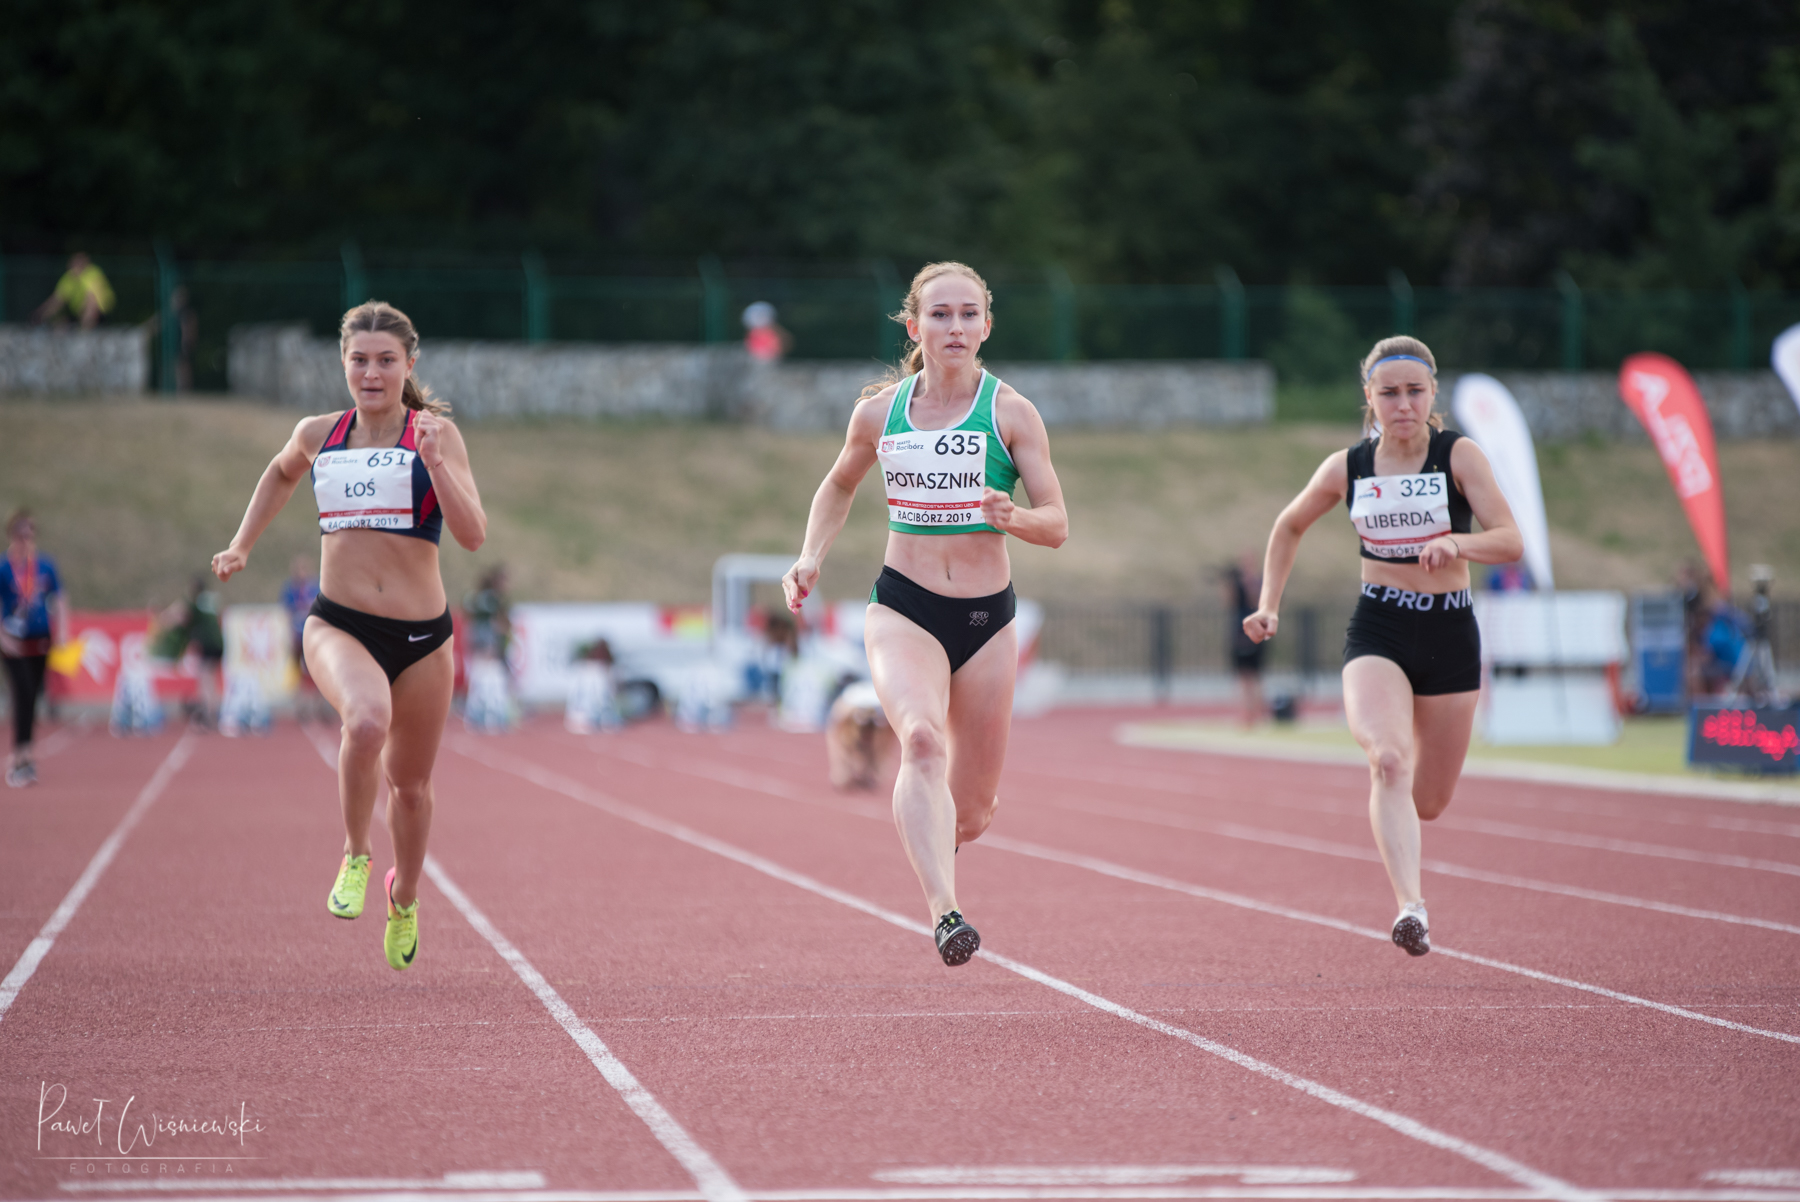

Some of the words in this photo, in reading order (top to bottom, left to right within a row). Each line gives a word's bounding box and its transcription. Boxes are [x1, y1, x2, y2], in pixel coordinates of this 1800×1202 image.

[896, 443, 924, 452] Racibórz
[934, 434, 981, 456] 635
[367, 450, 407, 468] 651
[344, 477, 376, 498] ŁOŚ
[885, 470, 982, 490] POTASZNIK
[1400, 477, 1442, 498] 325
[328, 516, 372, 530] RACIBÓRZ
[375, 517, 399, 527] 2019
[897, 510, 943, 523] RACIBÓRZ
[946, 512, 972, 523] 2019
[1365, 511, 1436, 529] LIBERDA
[1381, 586, 1435, 612] PRO
